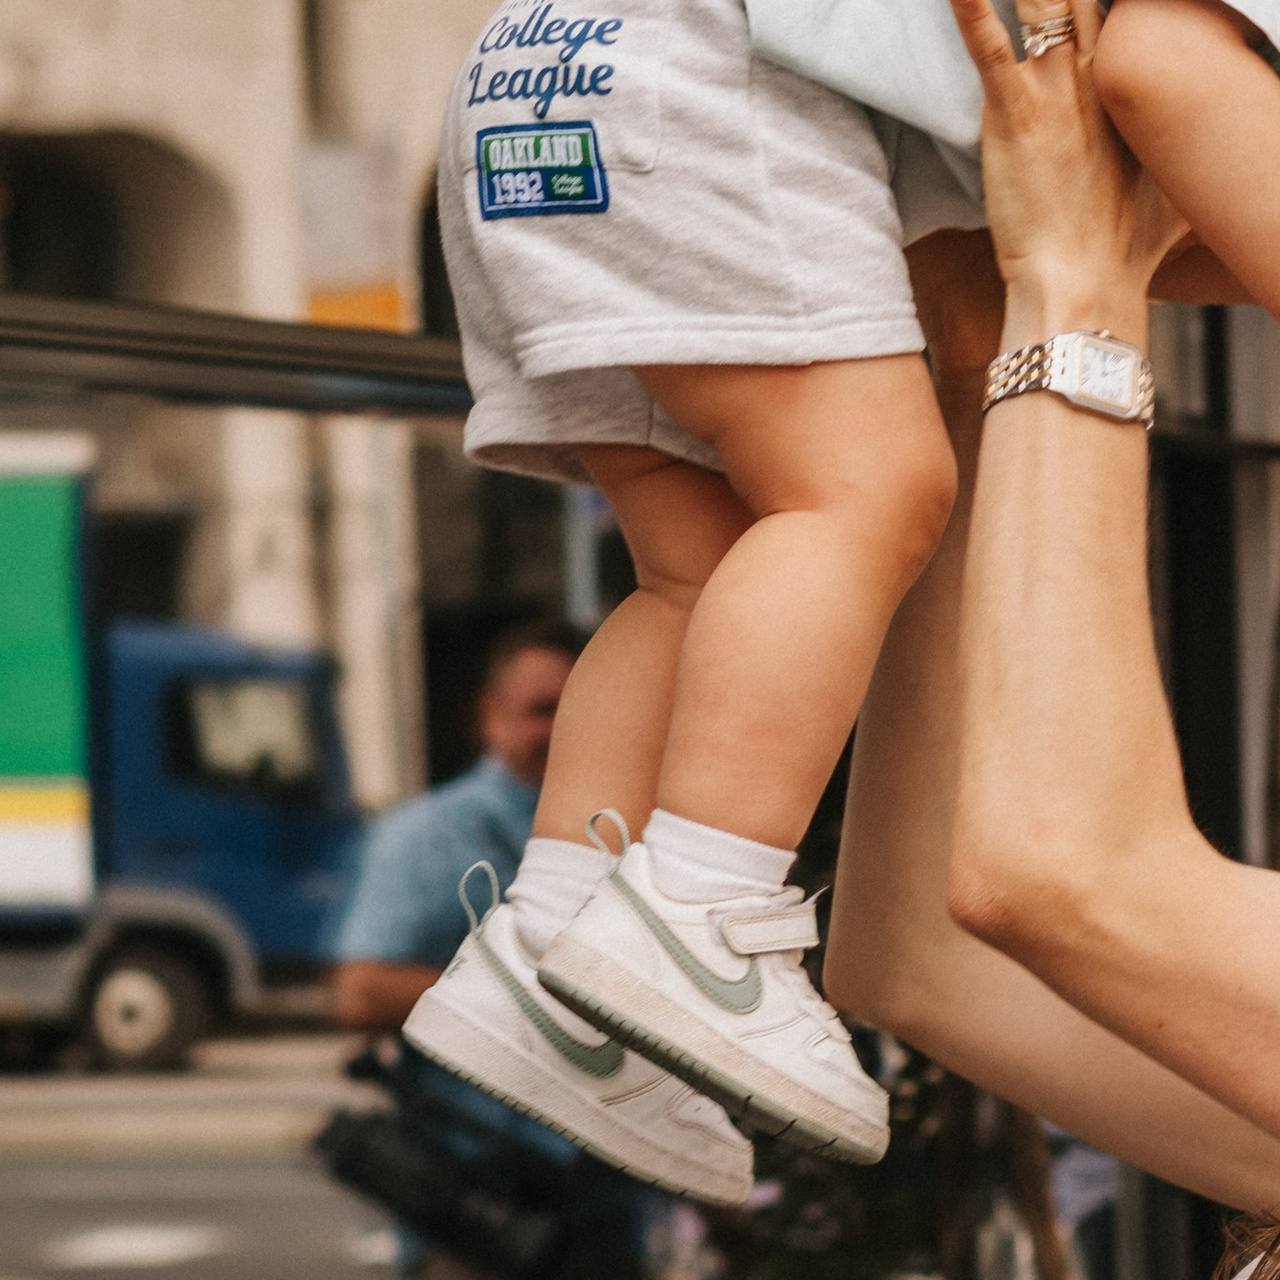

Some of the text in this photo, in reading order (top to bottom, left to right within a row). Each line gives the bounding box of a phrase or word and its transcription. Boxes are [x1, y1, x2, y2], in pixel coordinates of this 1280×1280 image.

[480, 3, 623, 63] College
[468, 61, 615, 119] League
[488, 134, 584, 170] OAKLAND
[491, 171, 545, 204] 1992
